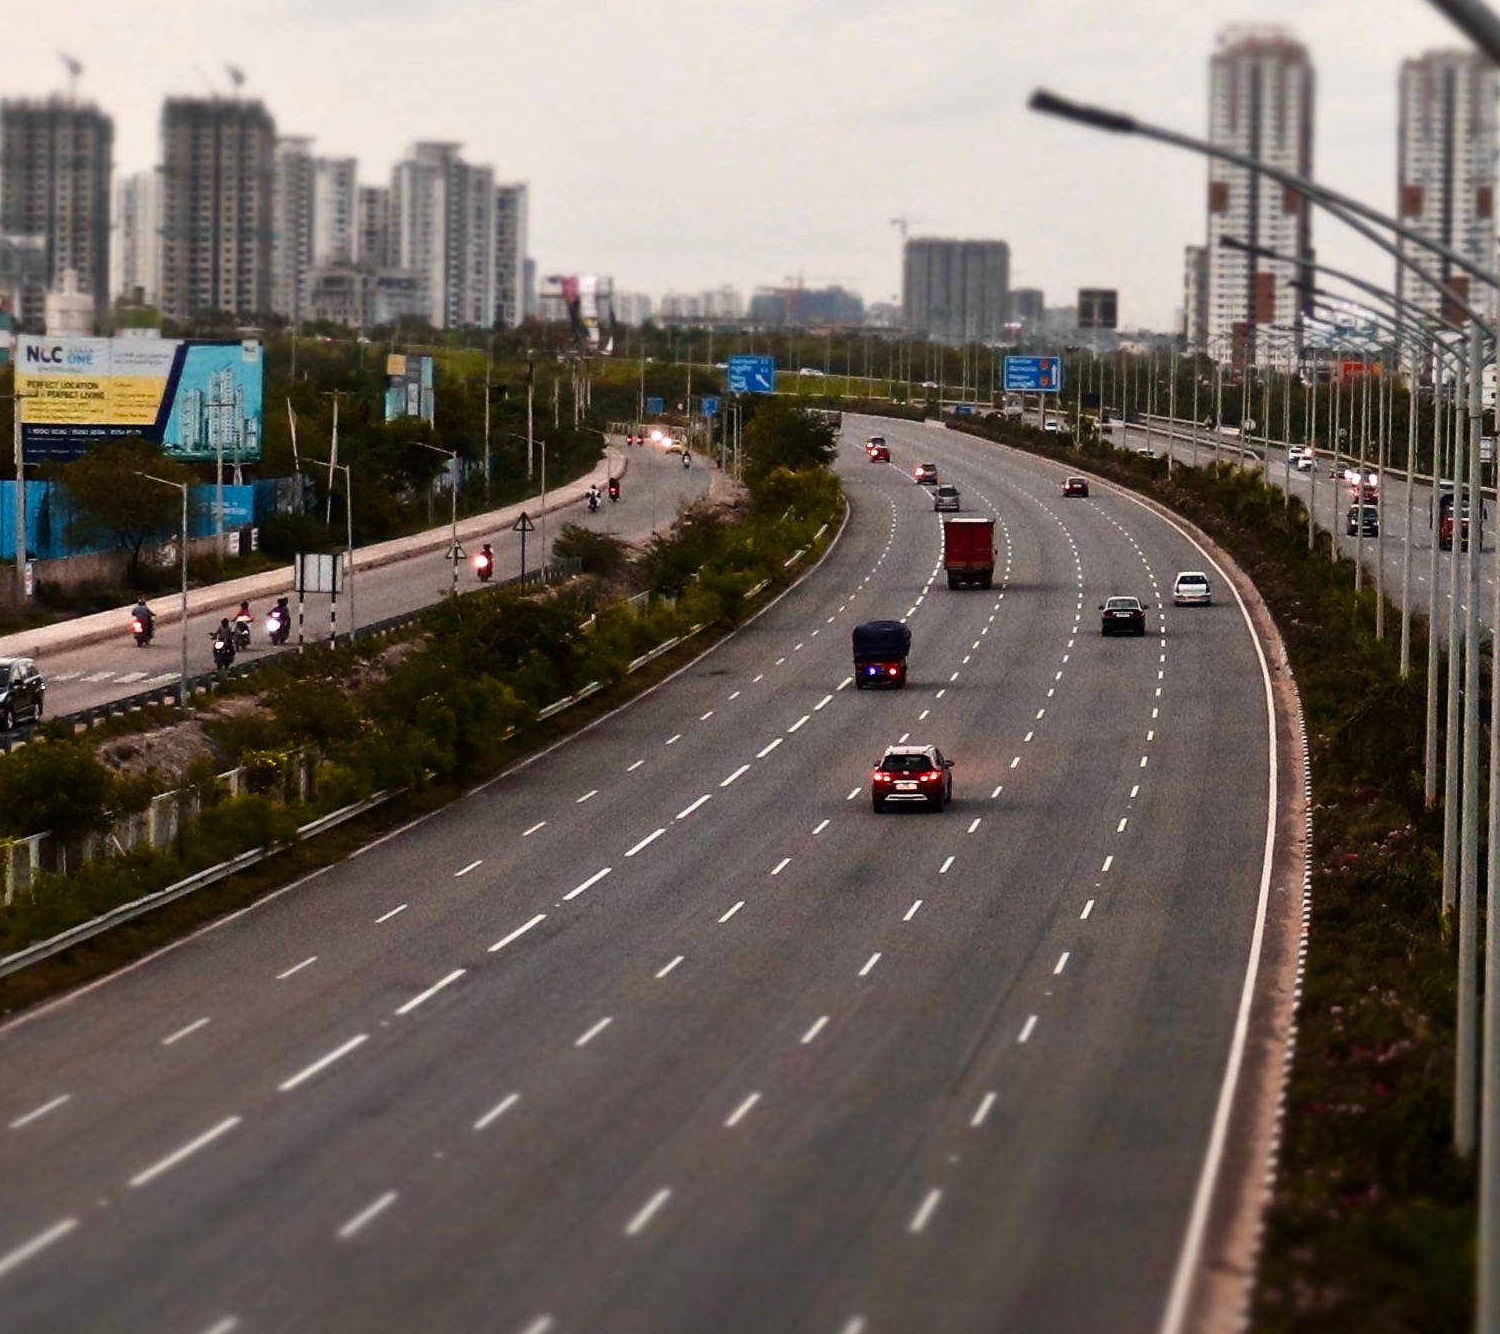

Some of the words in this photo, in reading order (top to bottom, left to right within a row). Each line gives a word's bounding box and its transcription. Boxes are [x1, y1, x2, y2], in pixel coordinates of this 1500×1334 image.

[26, 346, 63, 364] NCC
[26, 381, 58, 389] PERFECT
[61, 381, 99, 389] LOCATION
[80, 391, 105, 400] LIVING
